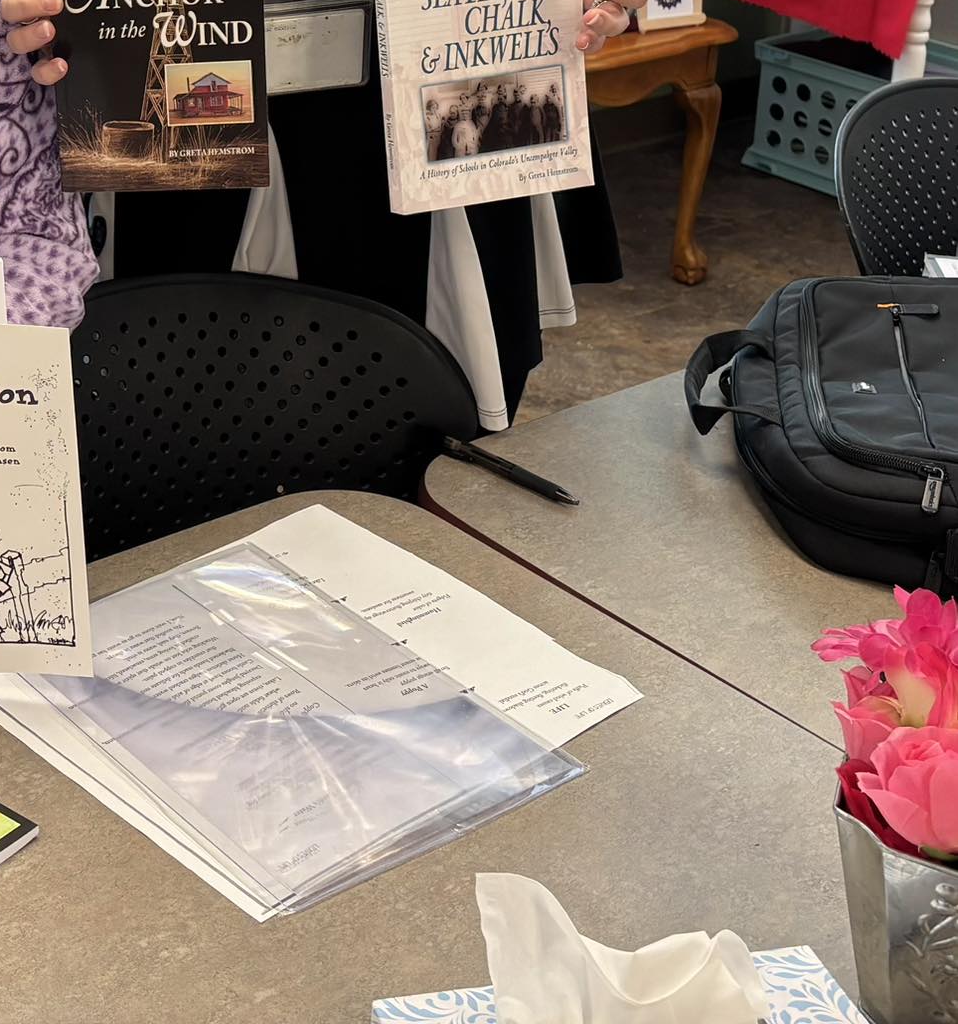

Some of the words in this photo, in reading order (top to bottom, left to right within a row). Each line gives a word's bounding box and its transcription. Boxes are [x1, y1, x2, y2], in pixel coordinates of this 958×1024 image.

[98, 22, 116, 40] in
[121, 20, 146, 39] the
[152, 11, 253, 48] WIND
[421, 46, 440, 74] &
[444, 26, 560, 71] INKWELLS
[169, 149, 179, 159] BY
[180, 148, 207, 157] GRETA
[207, 146, 255, 157] HEMSTROM
[480, 162, 487, 170] in
